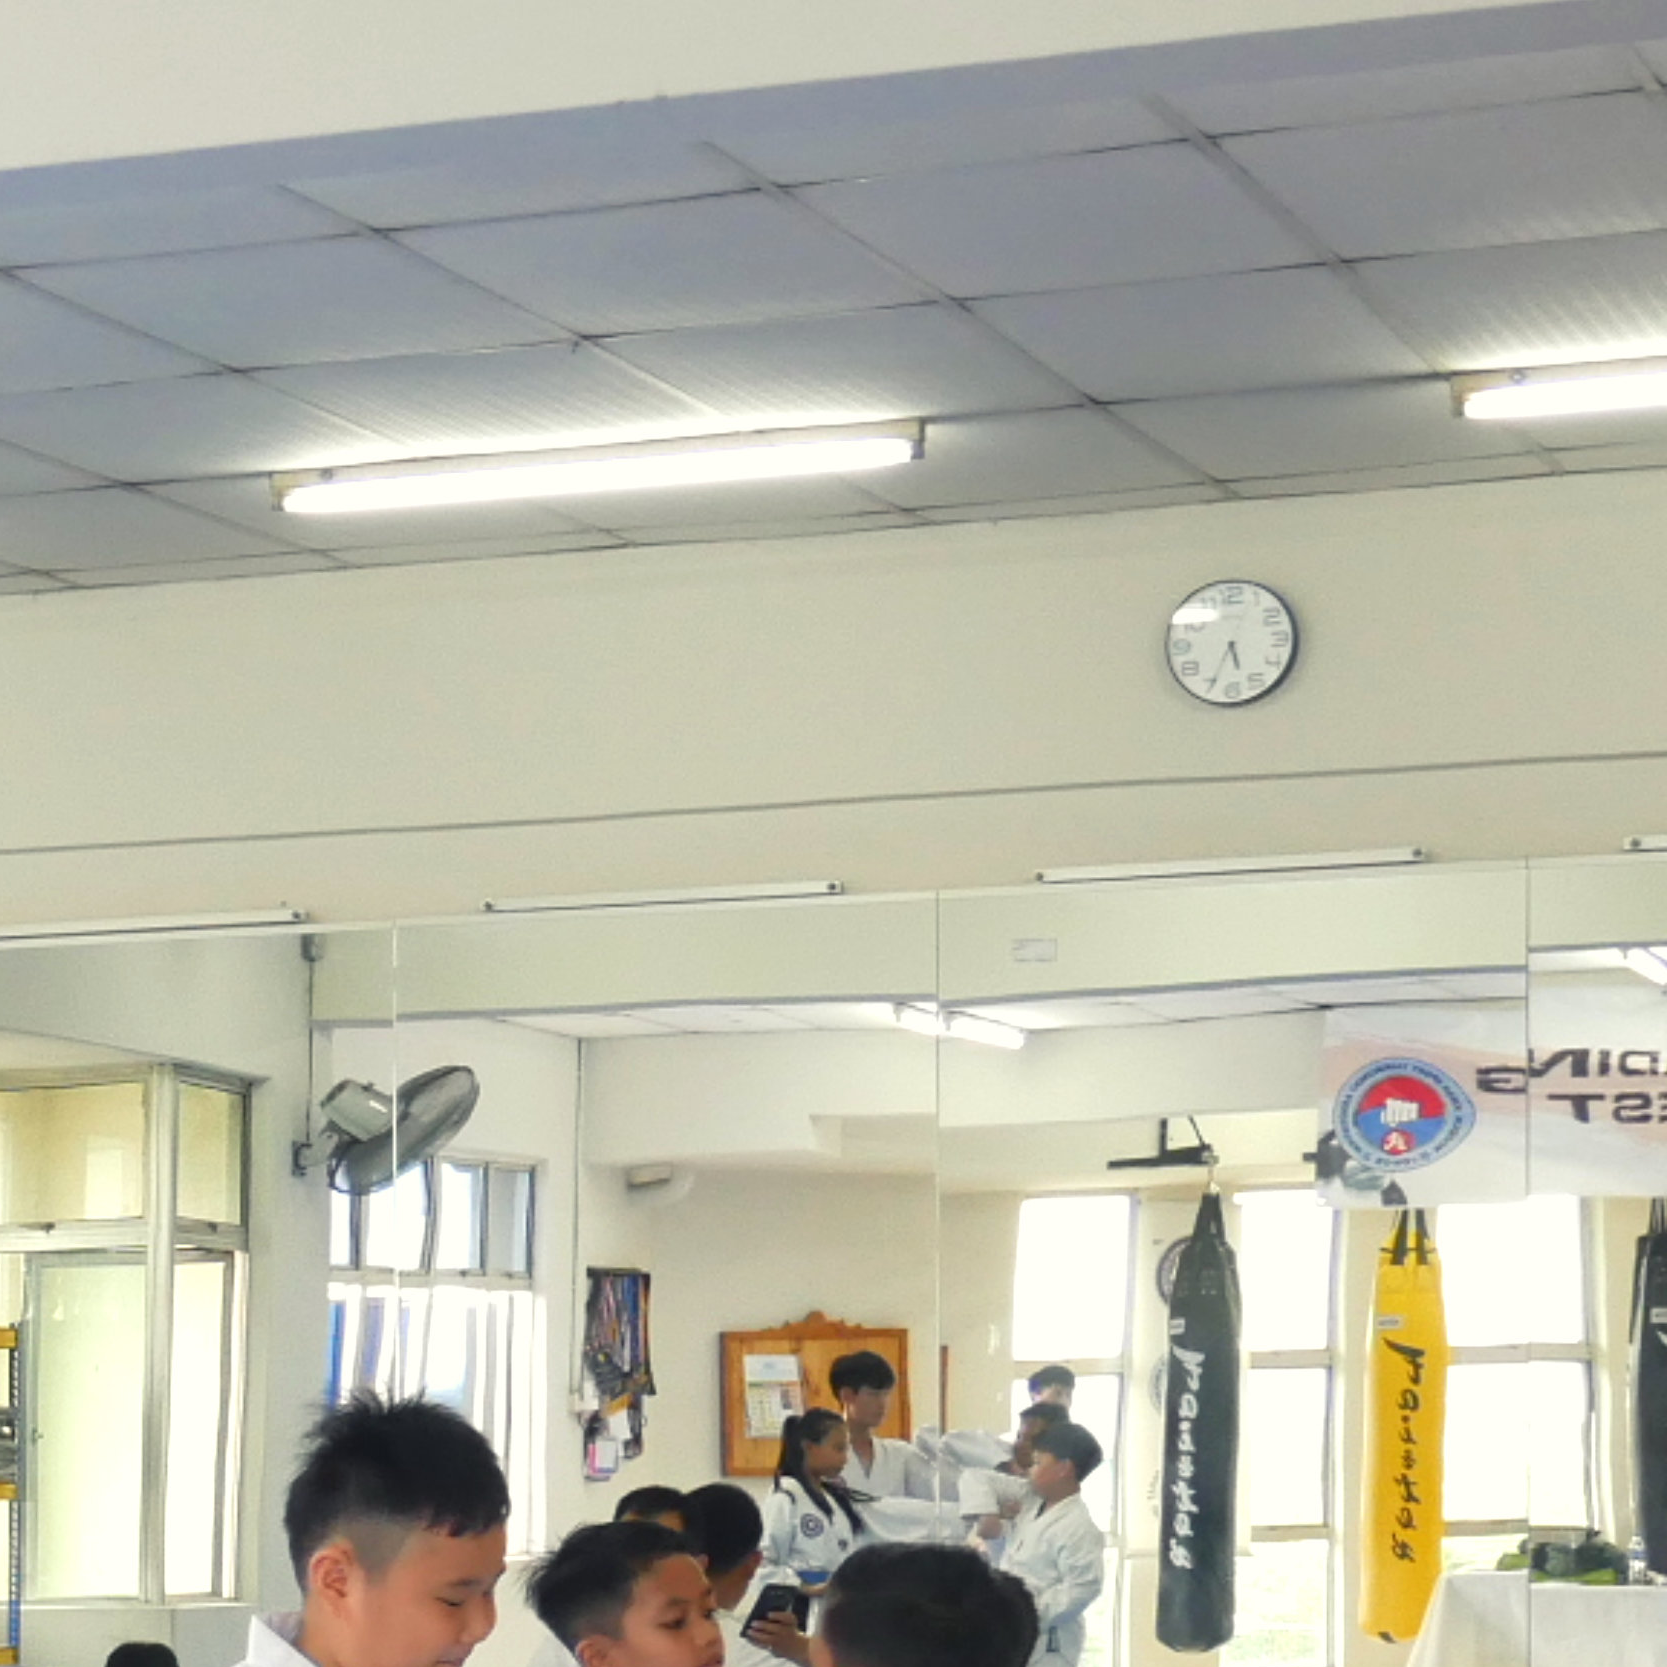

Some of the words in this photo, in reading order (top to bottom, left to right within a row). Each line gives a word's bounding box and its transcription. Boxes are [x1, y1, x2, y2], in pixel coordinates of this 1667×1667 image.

[1263, 607, 1281, 627] 2
[1270, 630, 1289, 648] 3
[1181, 661, 1200, 676] 8
